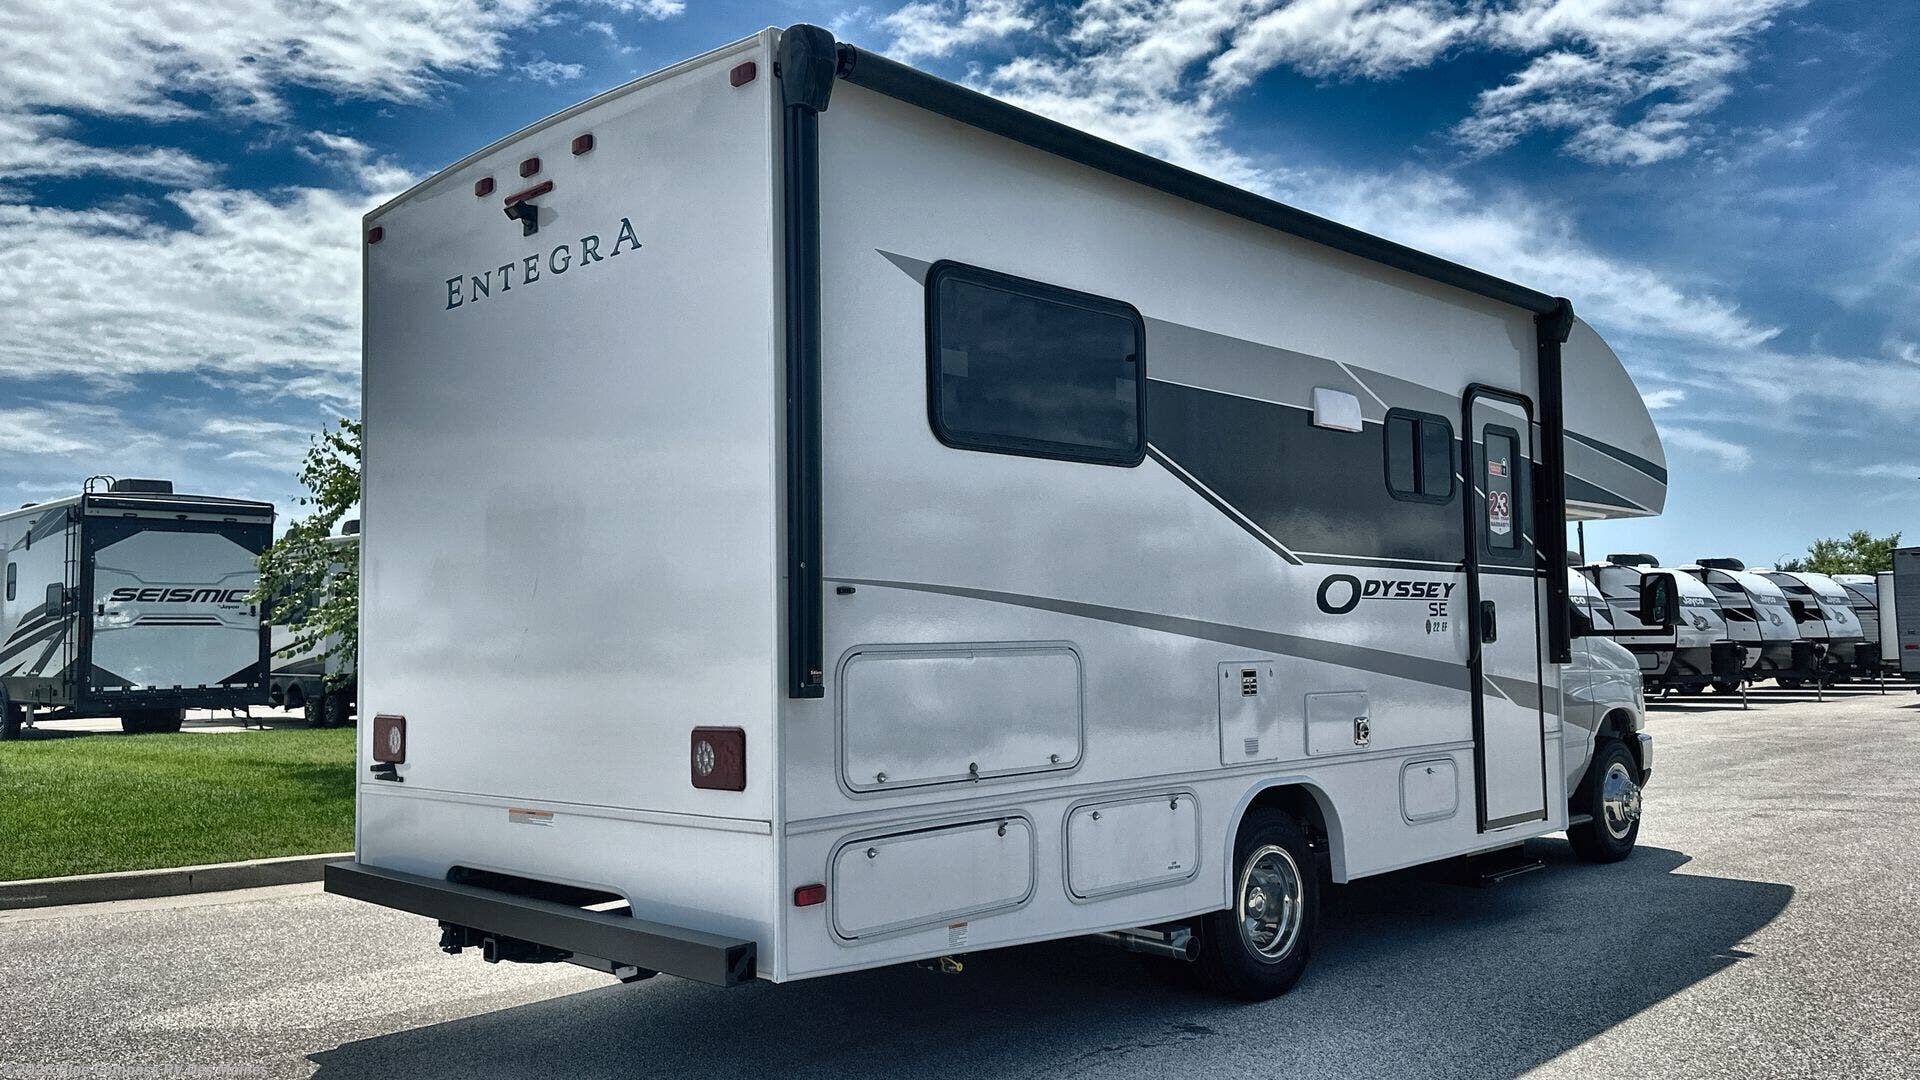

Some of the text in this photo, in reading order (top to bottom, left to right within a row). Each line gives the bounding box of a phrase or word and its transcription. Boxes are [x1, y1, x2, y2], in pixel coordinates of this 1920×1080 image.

[445, 217, 643, 311] ENTEGRA
[109, 587, 250, 603] SEISMIC
[1317, 574, 1456, 614] ODYSSEY
[1682, 593, 1705, 607] Jayco
[1428, 602, 1448, 617] SE
[1432, 621, 1448, 632] 22 EF
